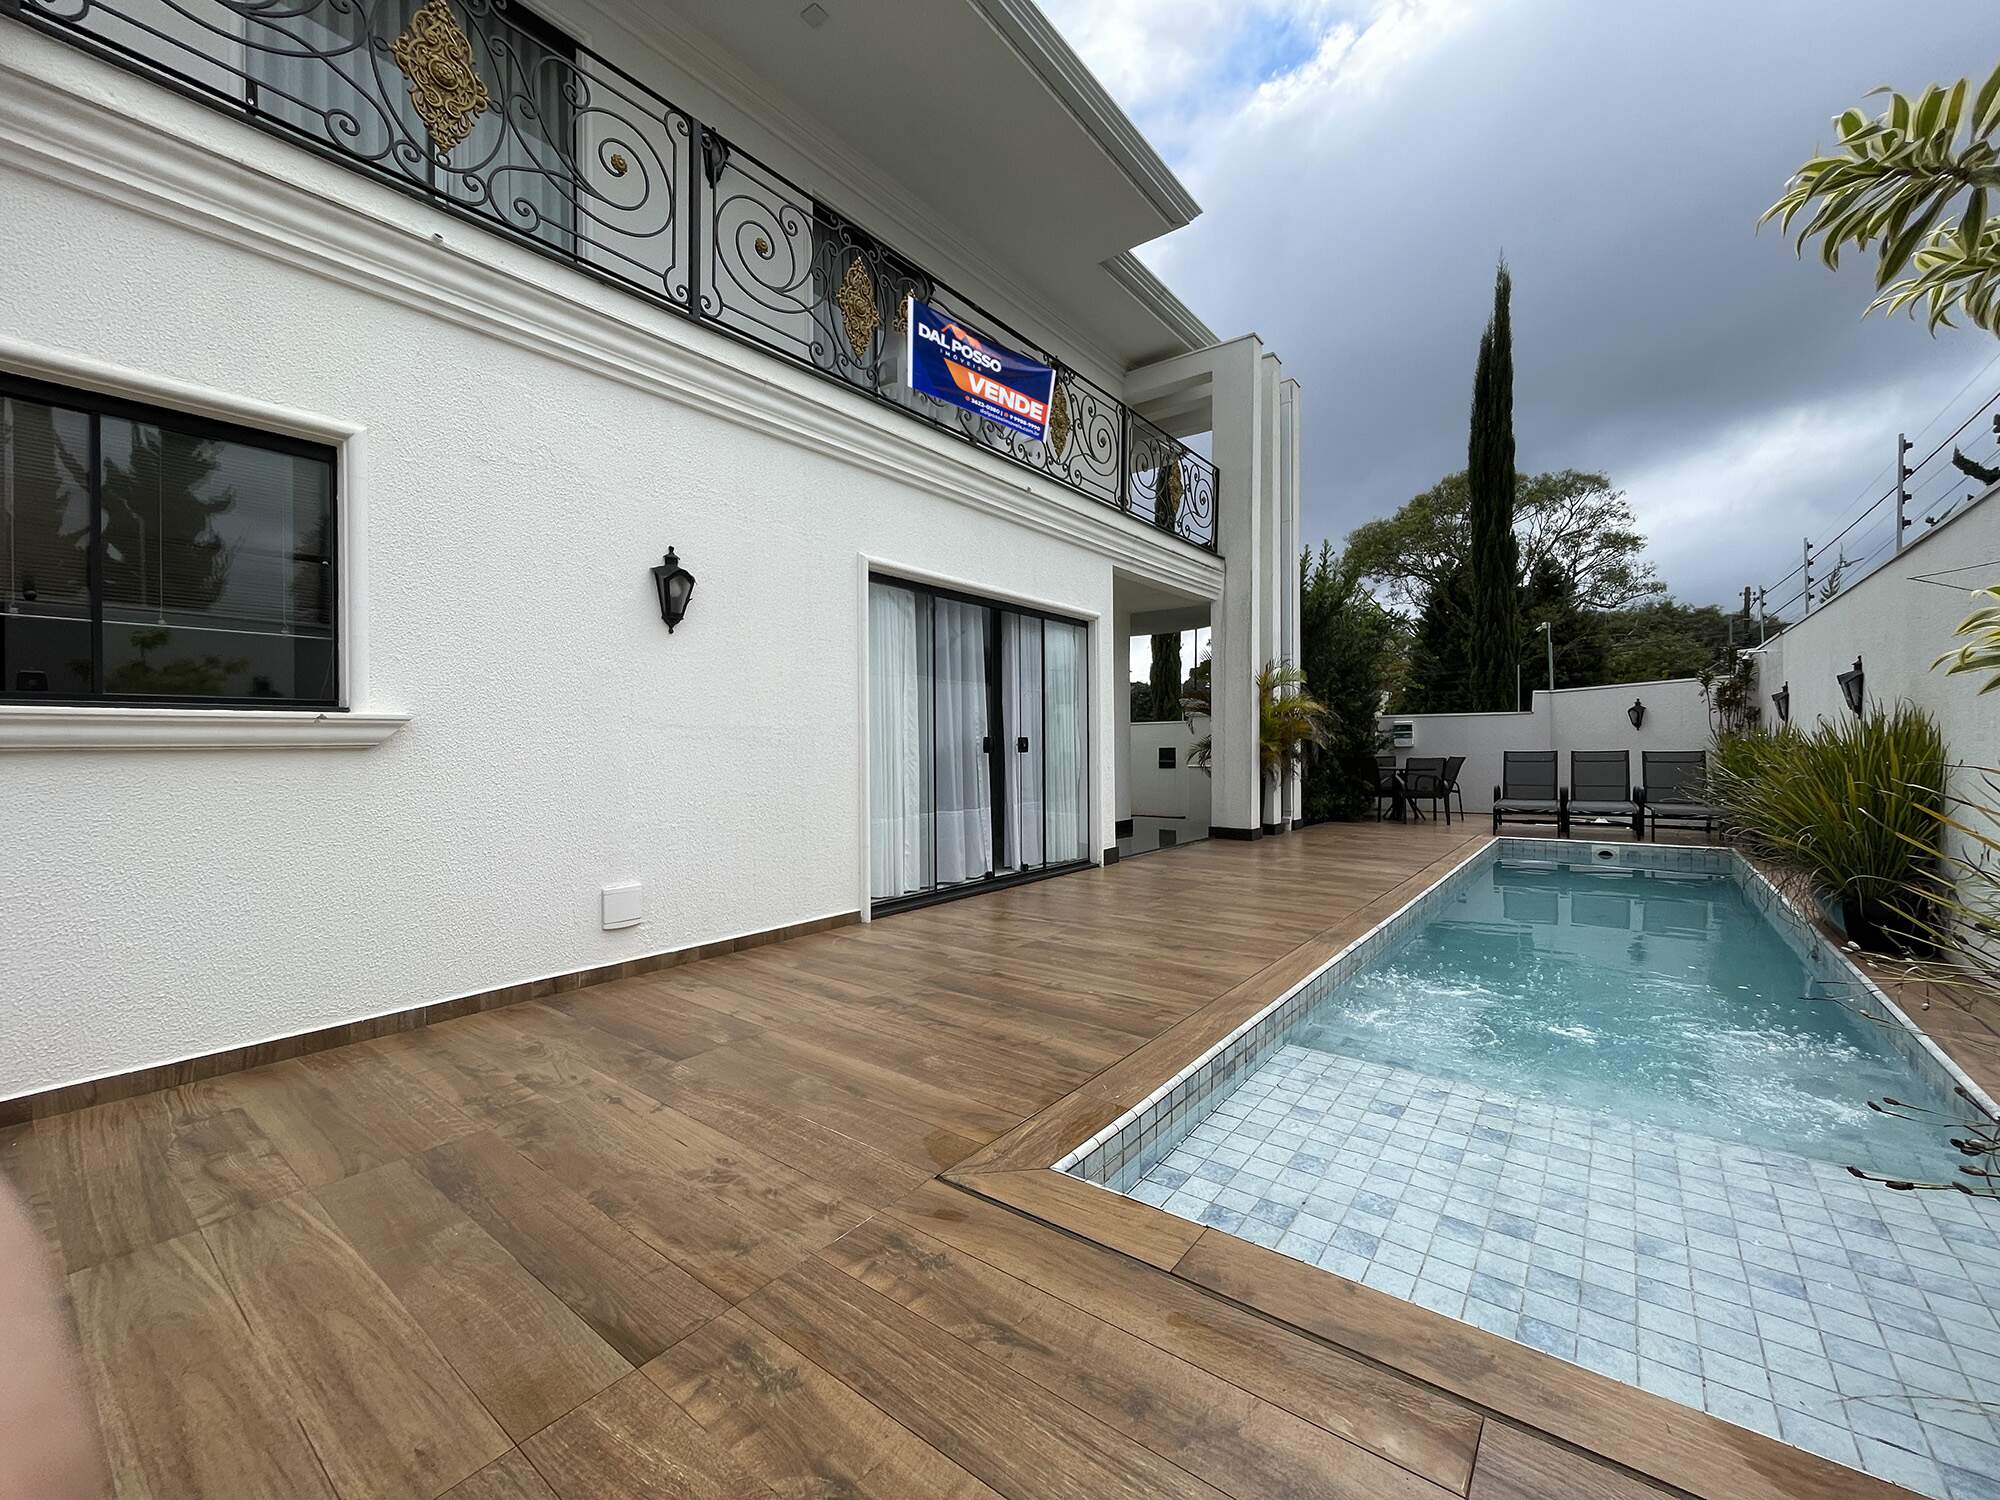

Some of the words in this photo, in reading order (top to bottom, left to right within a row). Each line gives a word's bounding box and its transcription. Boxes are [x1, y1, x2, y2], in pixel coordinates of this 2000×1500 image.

[918, 322, 951, 350] DAL
[951, 339, 1002, 373] POSSO
[967, 371, 1044, 422] VENDE
